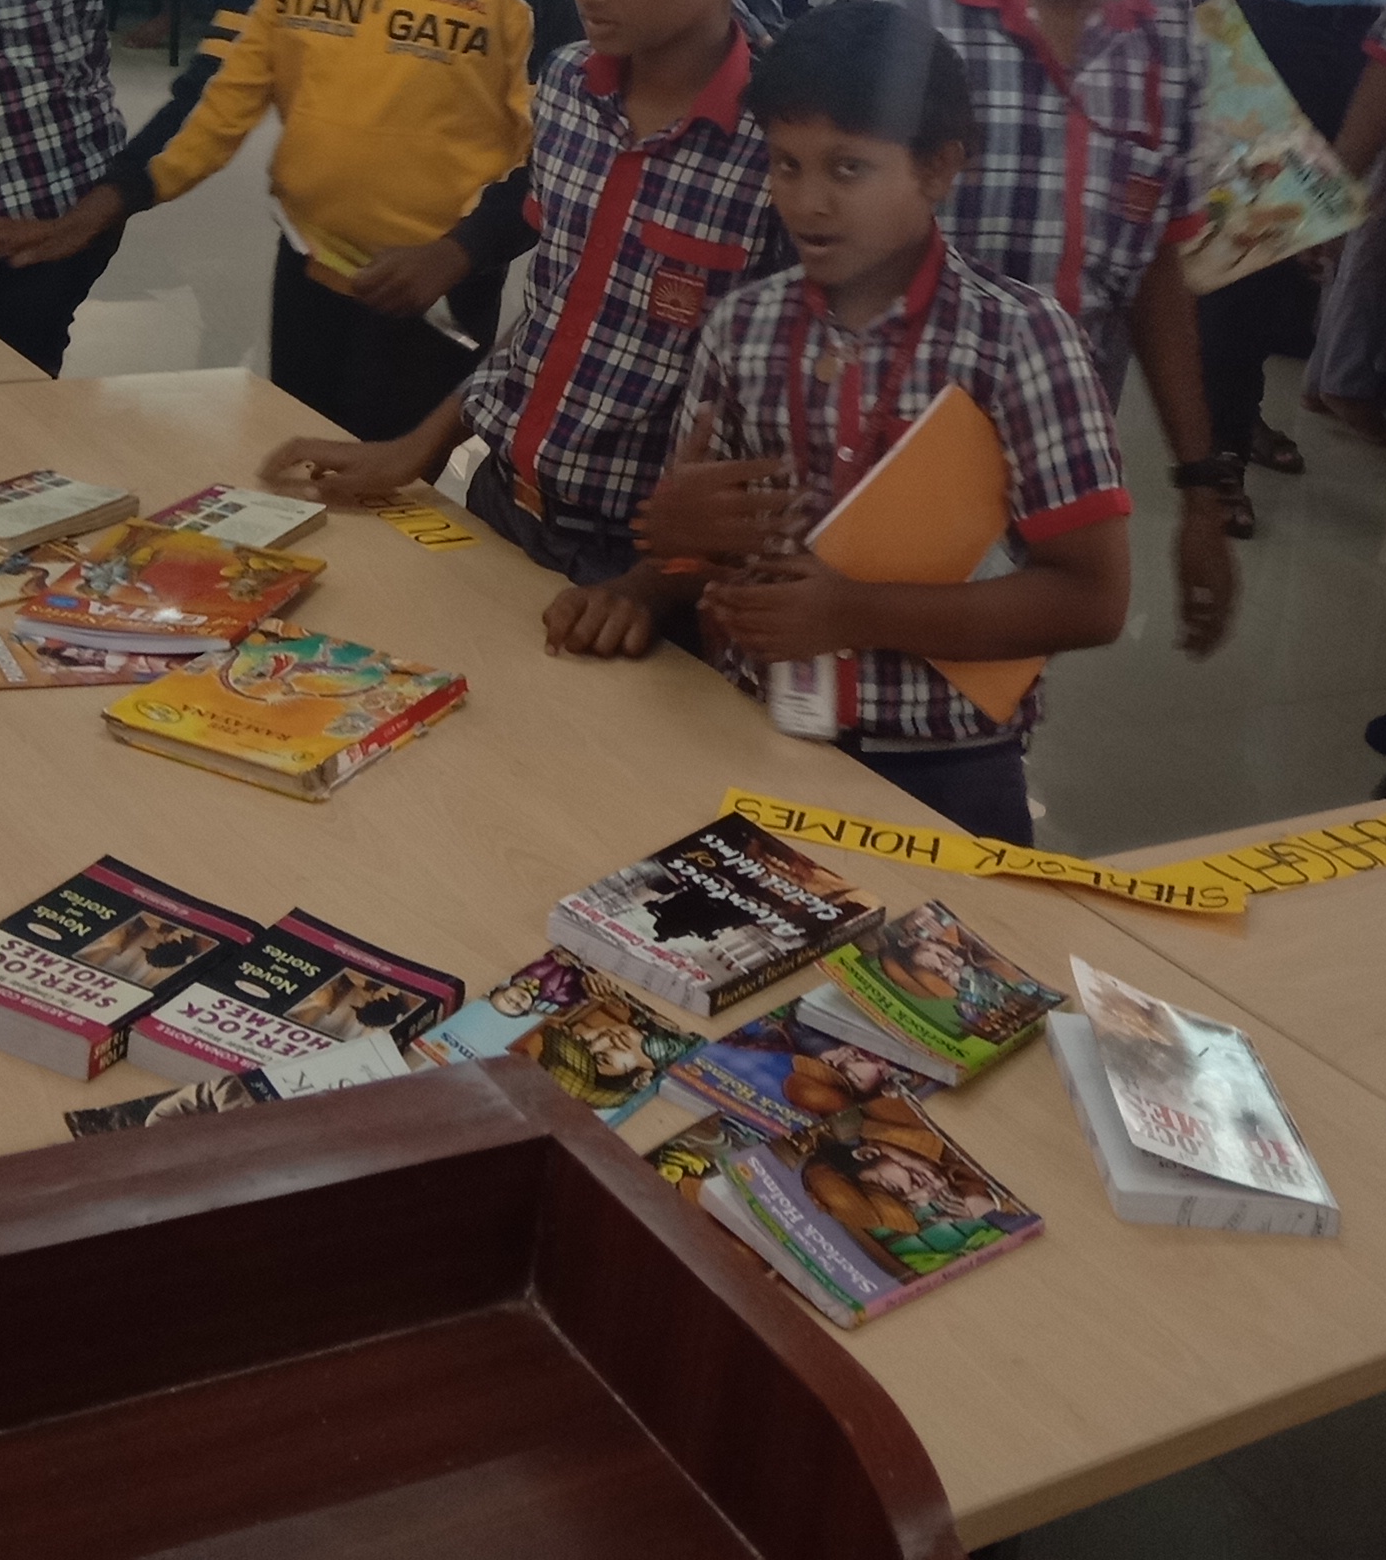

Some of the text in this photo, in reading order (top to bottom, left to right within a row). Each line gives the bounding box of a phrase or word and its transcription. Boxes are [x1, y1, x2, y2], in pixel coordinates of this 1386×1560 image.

[388, 9, 490, 55] GATA
[181, 703, 293, 743] RAMAYANA
[730, 795, 941, 864] HOLMES
[31, 902, 93, 938] Novels
[57, 887, 119, 922] Stories
[0, 936, 118, 992] HOLMES
[235, 959, 300, 996] Novels
[260, 942, 322, 979] Stories
[831, 954, 897, 1009] Holmes
[176, 1001, 311, 1063] ERLOCK
[210, 996, 333, 1053] HOLMES
[893, 1005, 972, 1062] Sherlock
[693, 1055, 758, 1101] Holmes
[758, 1096, 814, 1128] erlock
[743, 1154, 806, 1225] Holmes
[799, 1221, 881, 1297] Sherlock
